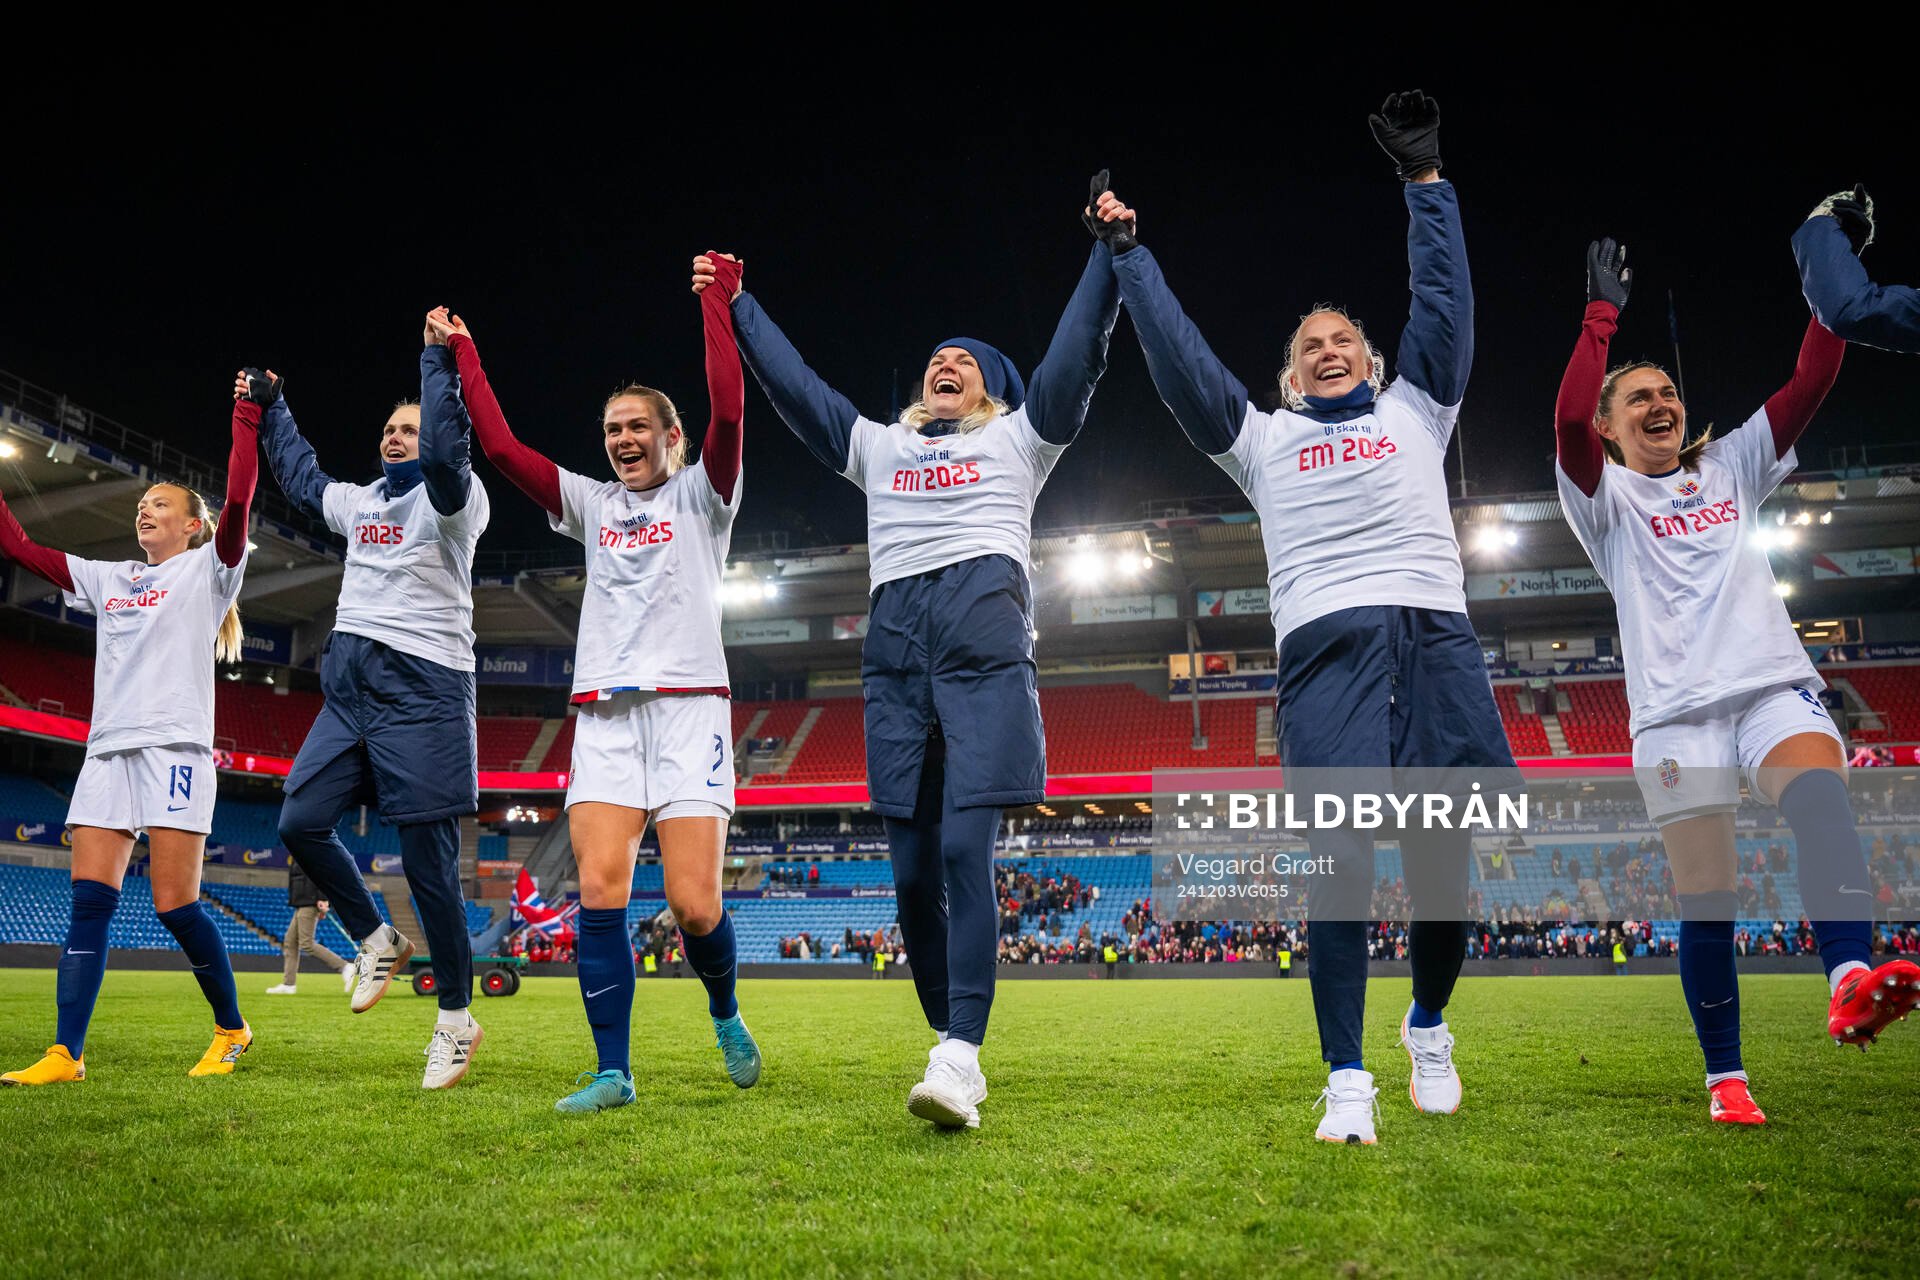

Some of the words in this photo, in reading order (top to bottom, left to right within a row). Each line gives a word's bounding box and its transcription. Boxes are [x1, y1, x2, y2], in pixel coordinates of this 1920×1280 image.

[1336, 423, 1359, 434] skal
[1362, 424, 1372, 435] til
[920, 451, 937, 463] skal
[939, 449, 950, 460] til
[1341, 436, 1397, 463] 2025
[923, 461, 981, 491] 2025
[372, 511, 380, 520] til
[621, 516, 638, 529] kal
[637, 512, 648, 523] til
[1685, 499, 1740, 534] 2025
[360, 524, 404, 545] 2025
[626, 521, 673, 549] 2025
[1521, 578, 1559, 591] Norsk
[712, 734, 724, 772] 3
